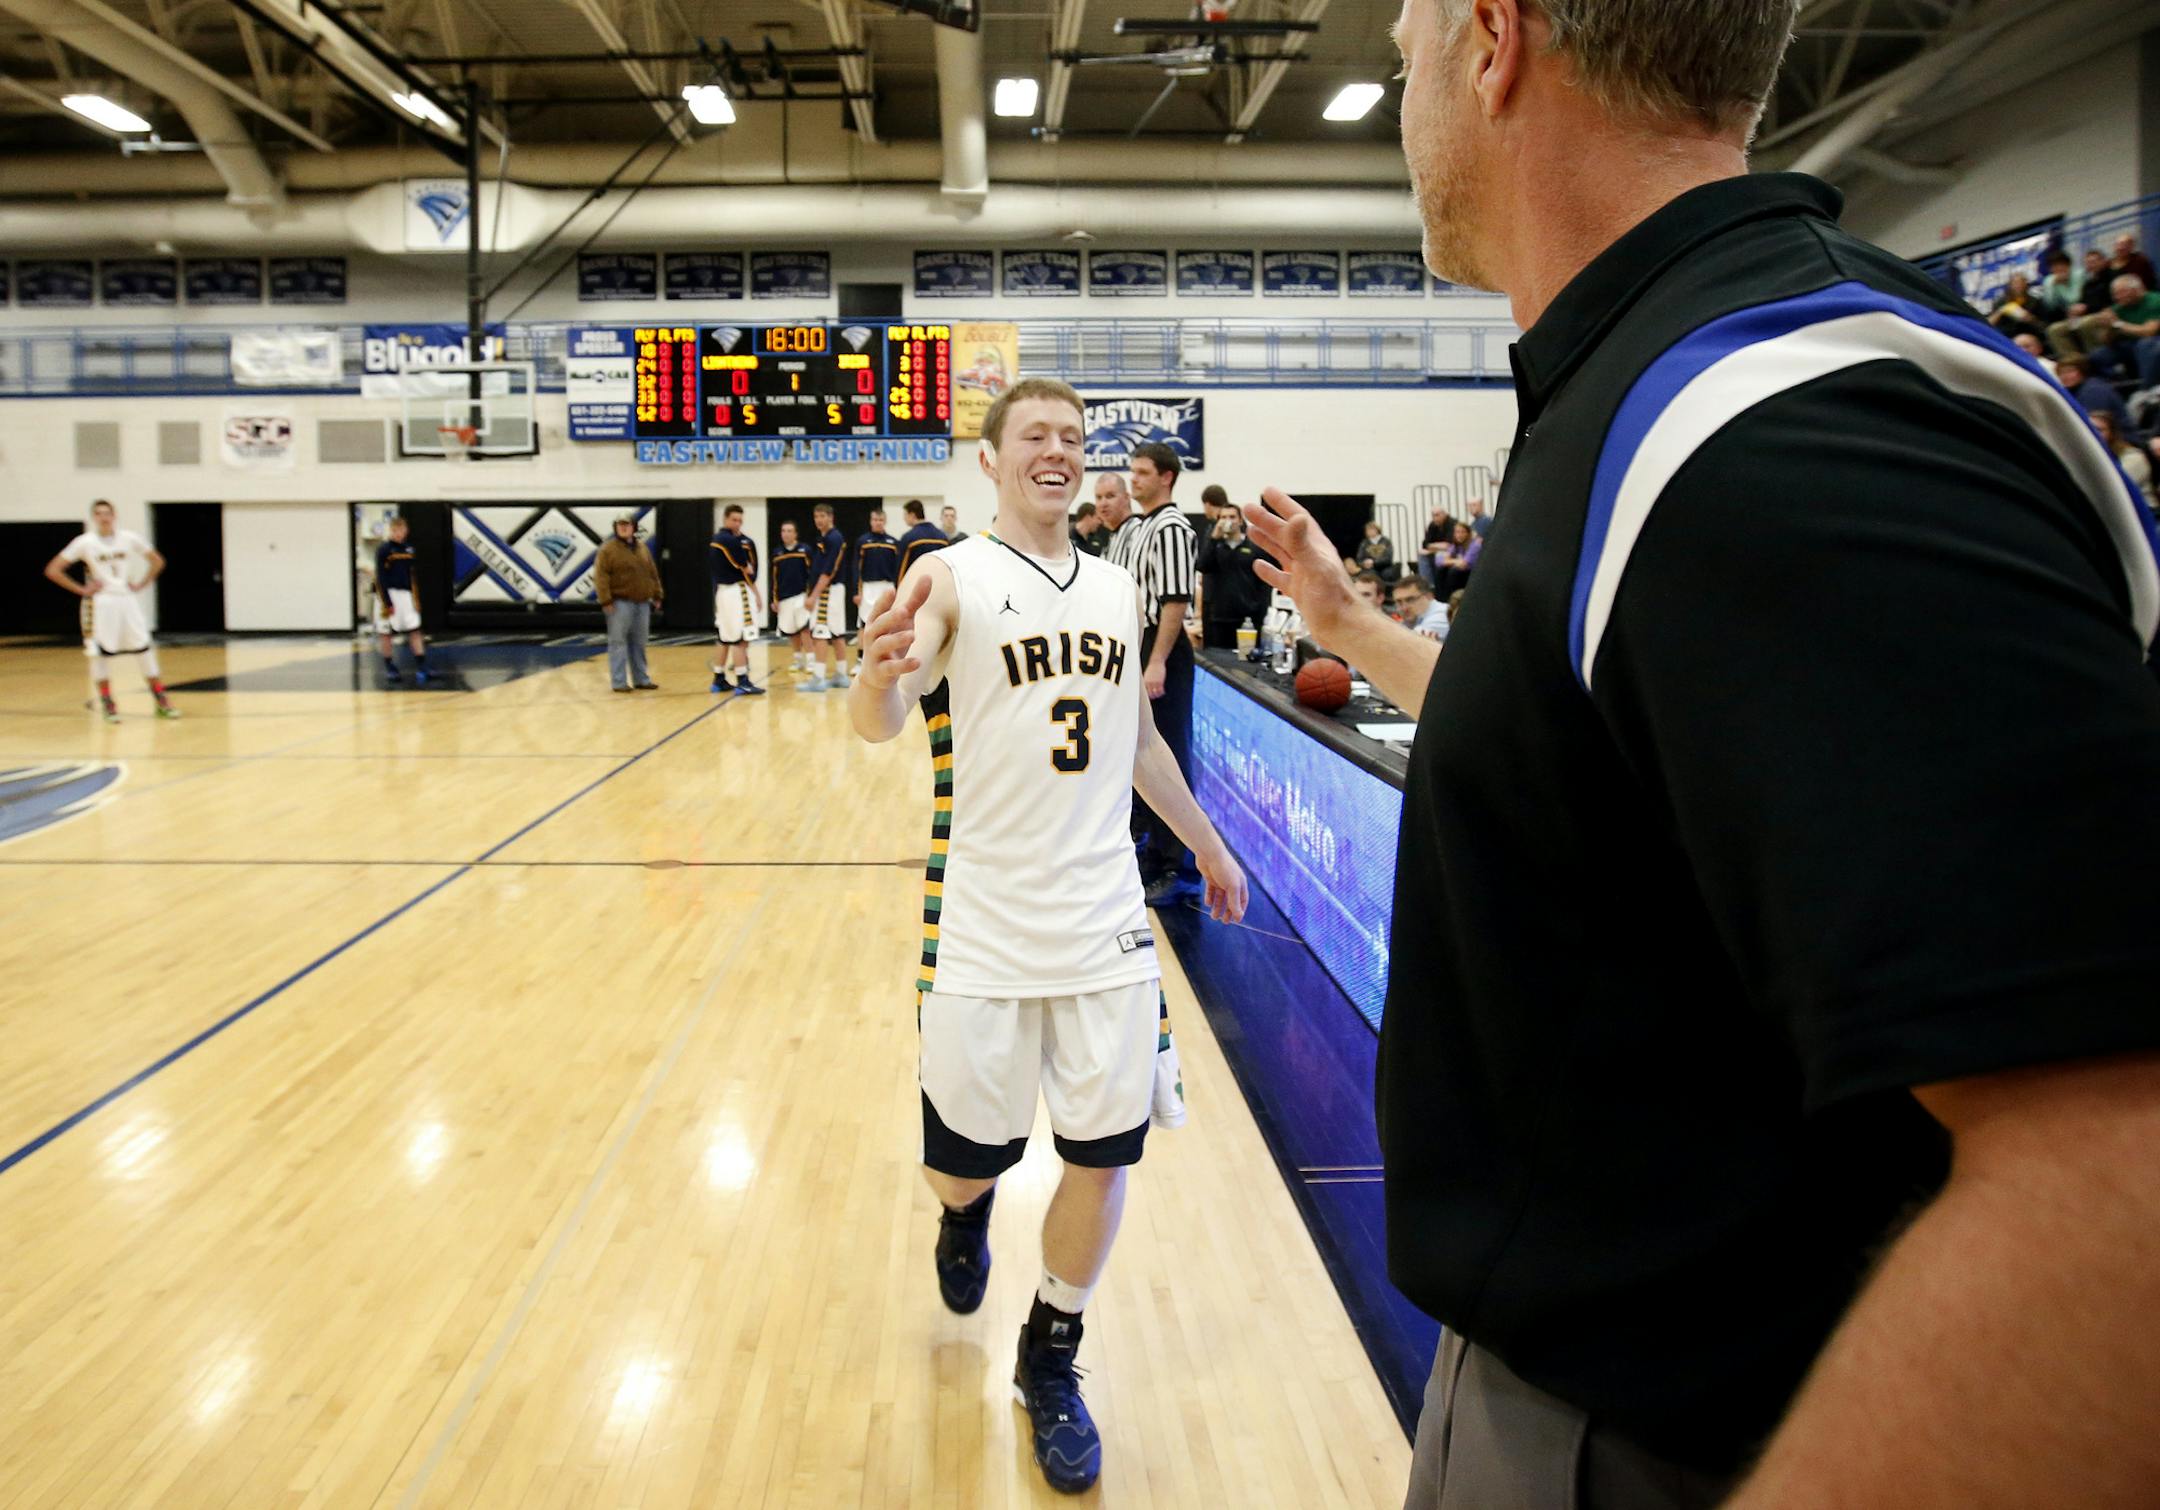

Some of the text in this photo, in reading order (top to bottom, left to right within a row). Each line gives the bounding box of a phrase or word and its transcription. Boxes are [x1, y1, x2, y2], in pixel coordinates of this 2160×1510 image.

[766, 327, 826, 352] 18:00
[731, 370, 749, 396] 0
[791, 372, 799, 391] 1
[857, 369, 874, 394] 0
[715, 404, 731, 426] 0
[859, 403, 875, 425] 0
[637, 438, 949, 464] EASTVIEW LIGHTNING
[466, 534, 529, 591] BUILDING
[1000, 631, 1126, 688] IRISH
[1051, 696, 1091, 775] 3
